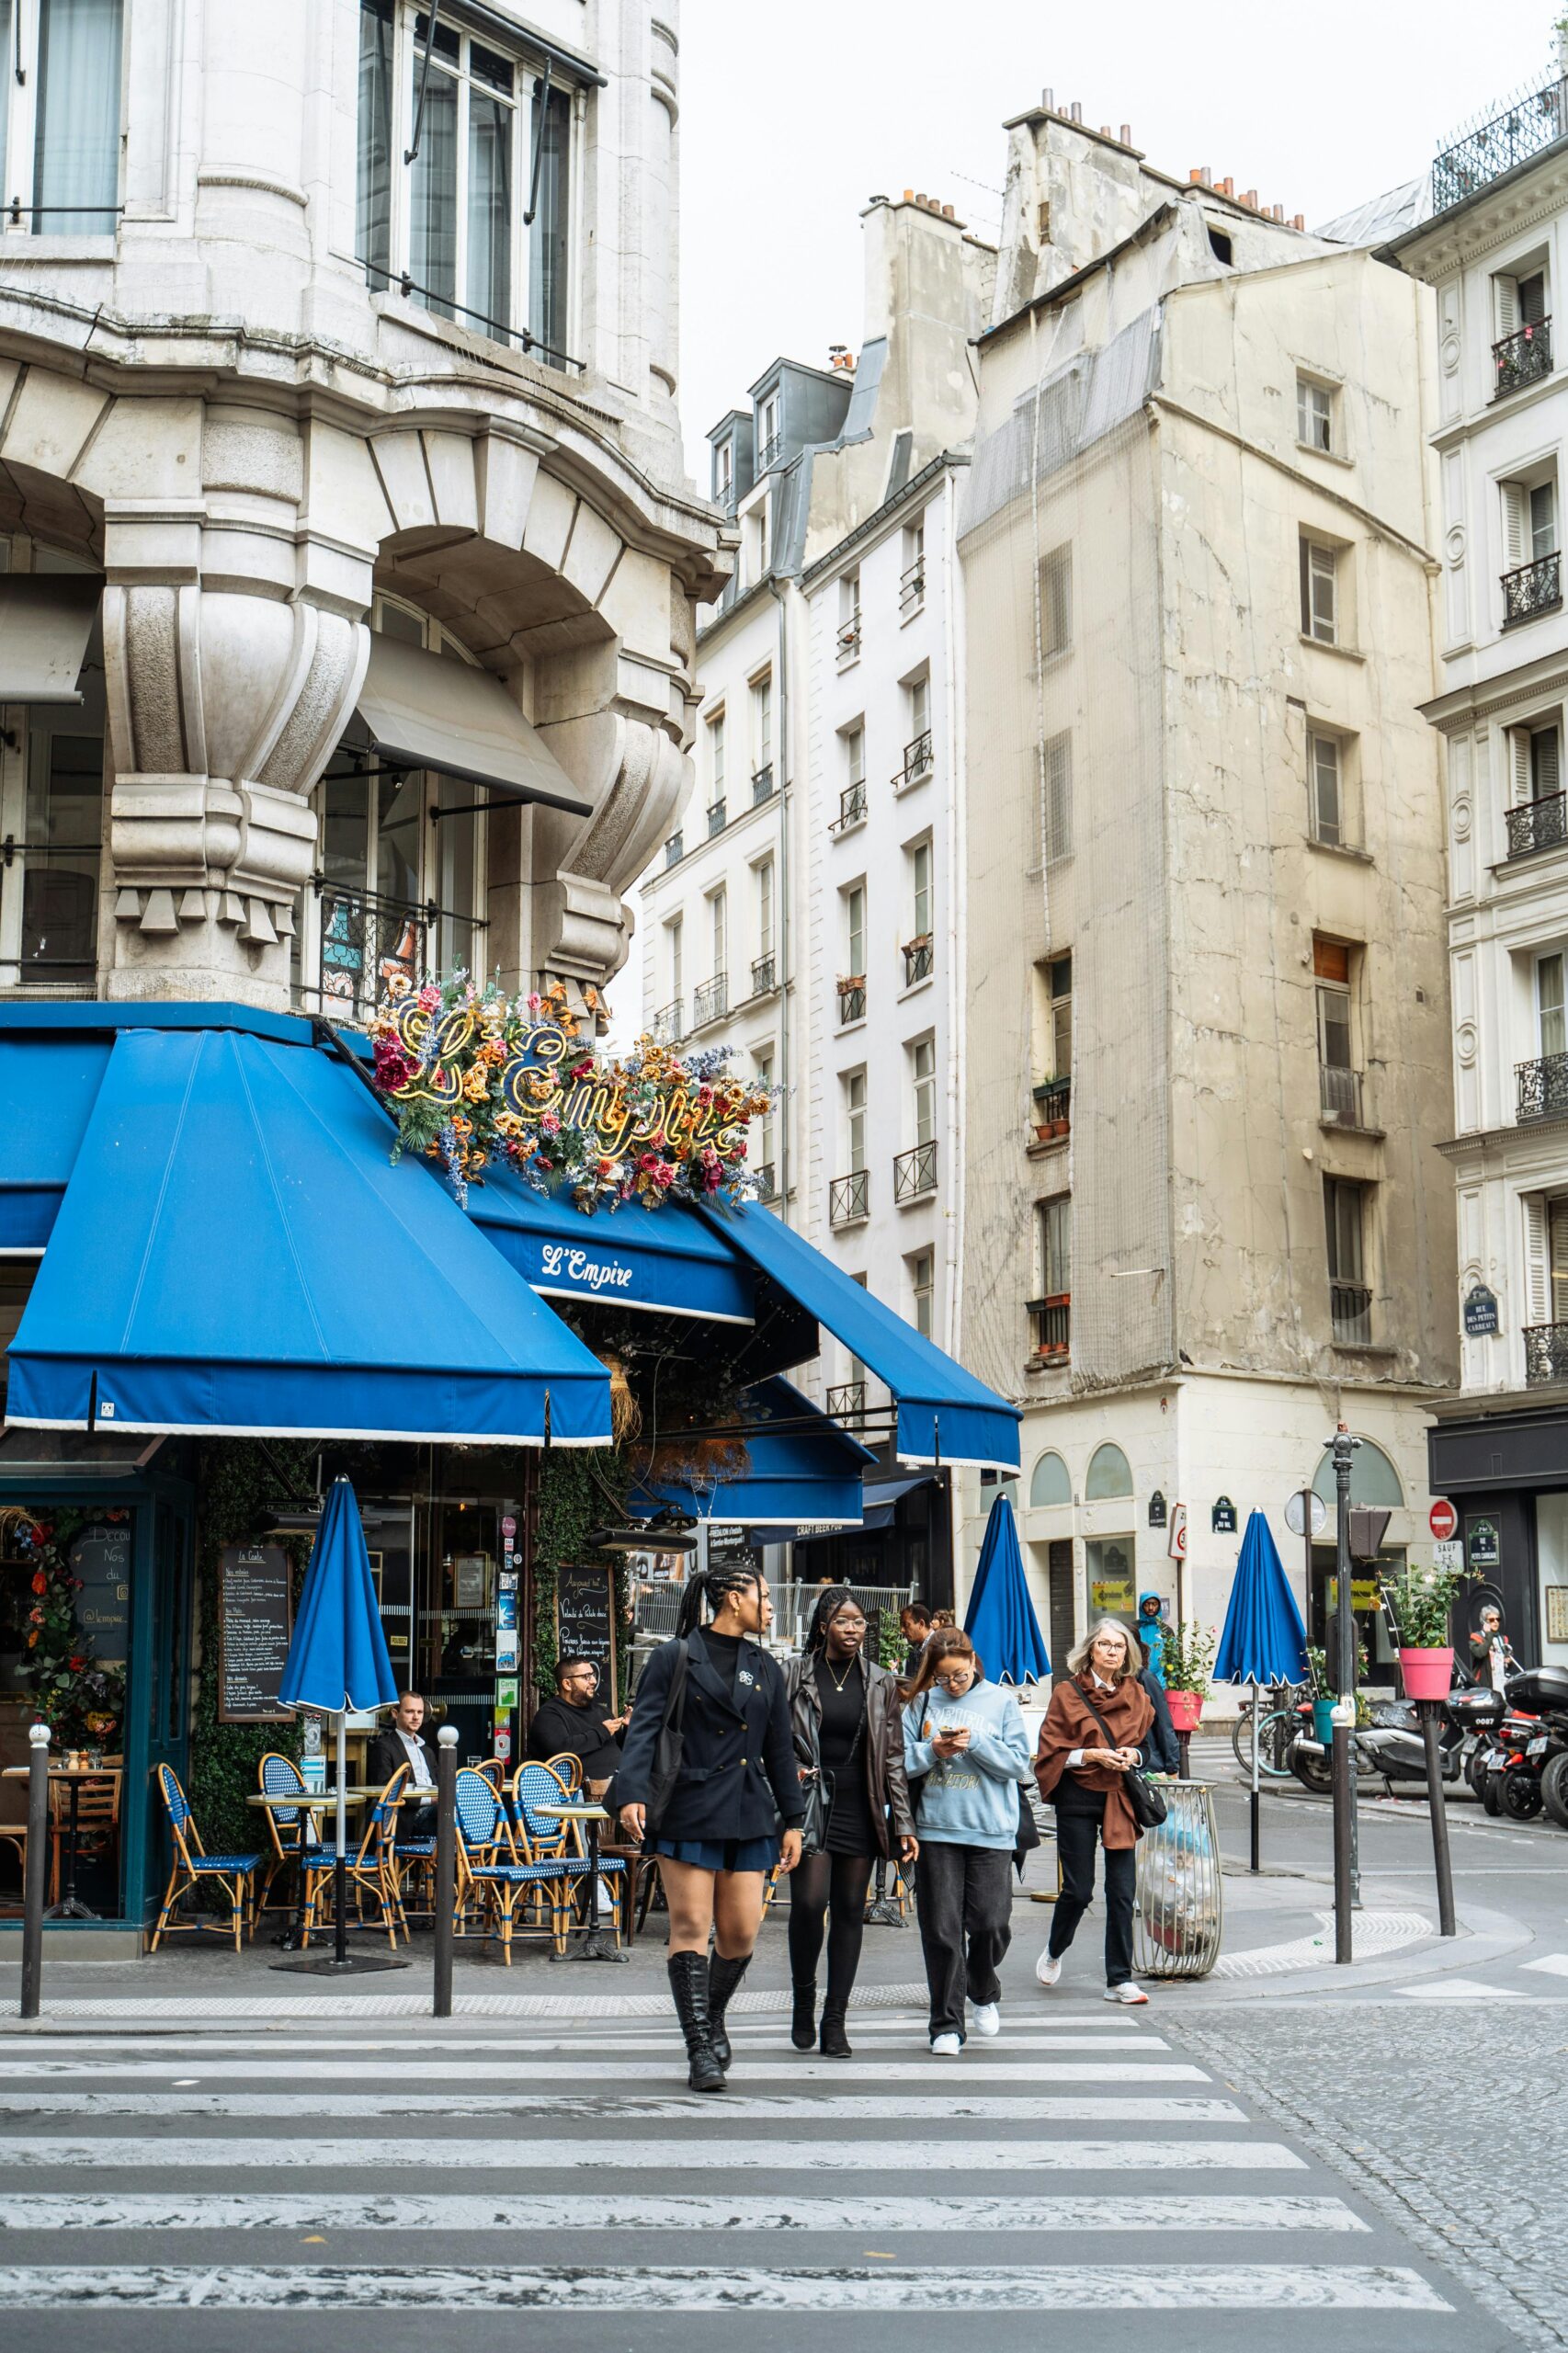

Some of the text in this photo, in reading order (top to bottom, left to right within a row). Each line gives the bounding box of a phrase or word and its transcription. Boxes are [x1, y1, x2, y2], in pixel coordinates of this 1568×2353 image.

[541, 1244, 633, 1290] L'Empire
[1475, 1305, 1486, 1313] RUE
[1467, 1313, 1495, 1324] DES PETITS
[1468, 1321, 1495, 1332] CARREAUX
[797, 1525, 814, 1536] CRAFT
[1437, 1543, 1457, 1552] SAUF
[104, 1546, 125, 1563] Nos
[238, 1551, 246, 1561] La
[106, 1567, 121, 1580] du
